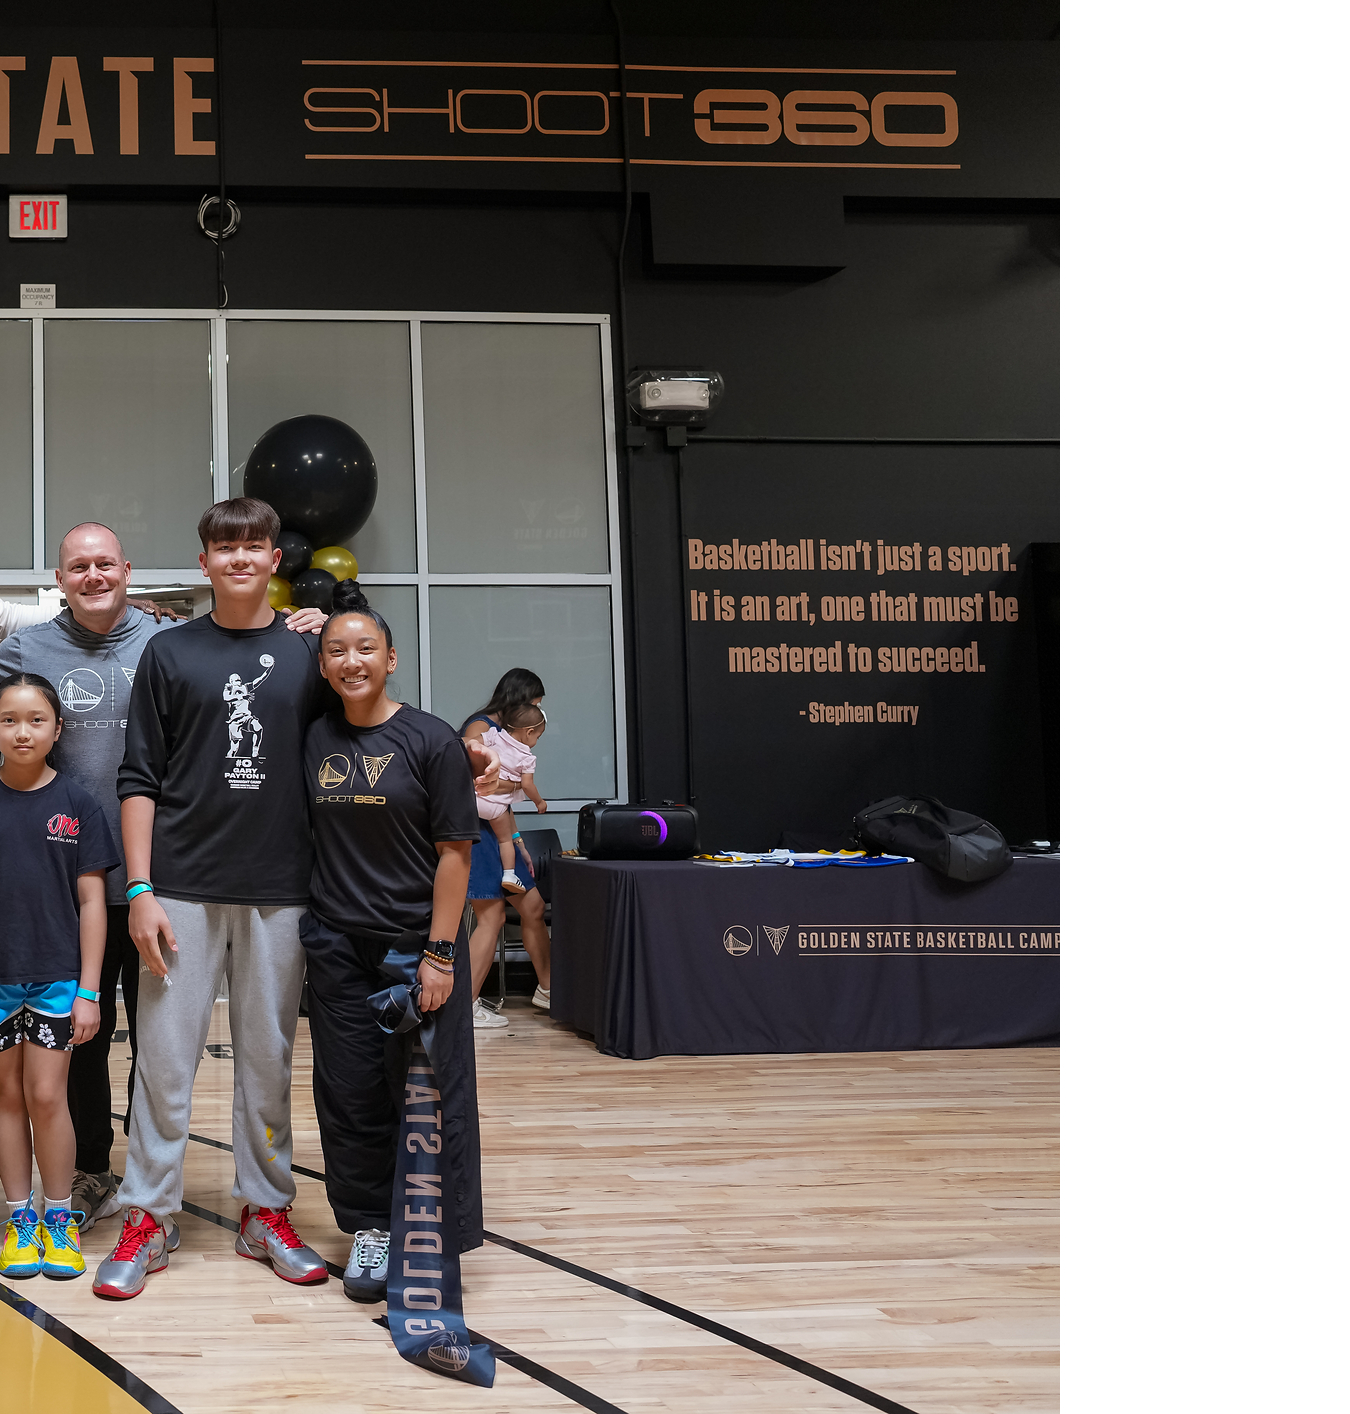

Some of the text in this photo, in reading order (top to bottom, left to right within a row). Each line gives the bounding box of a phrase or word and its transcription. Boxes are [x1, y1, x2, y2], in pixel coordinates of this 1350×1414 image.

[19, 200, 60, 231] EXIT
[688, 539, 1017, 575] Basketball isn't just a sport.
[690, 590, 1019, 626] It is an art, one that must be
[728, 641, 986, 673] mastered to succeed.
[809, 701, 873, 726] Stephen
[876, 702, 919, 726] Curry
[224, 772, 260, 780] PAYTON
[641, 825, 659, 837] JBL
[798, 932, 861, 949] GOLDEN
[866, 931, 911, 949] STATE
[916, 931, 1015, 949] BASKETBALL
